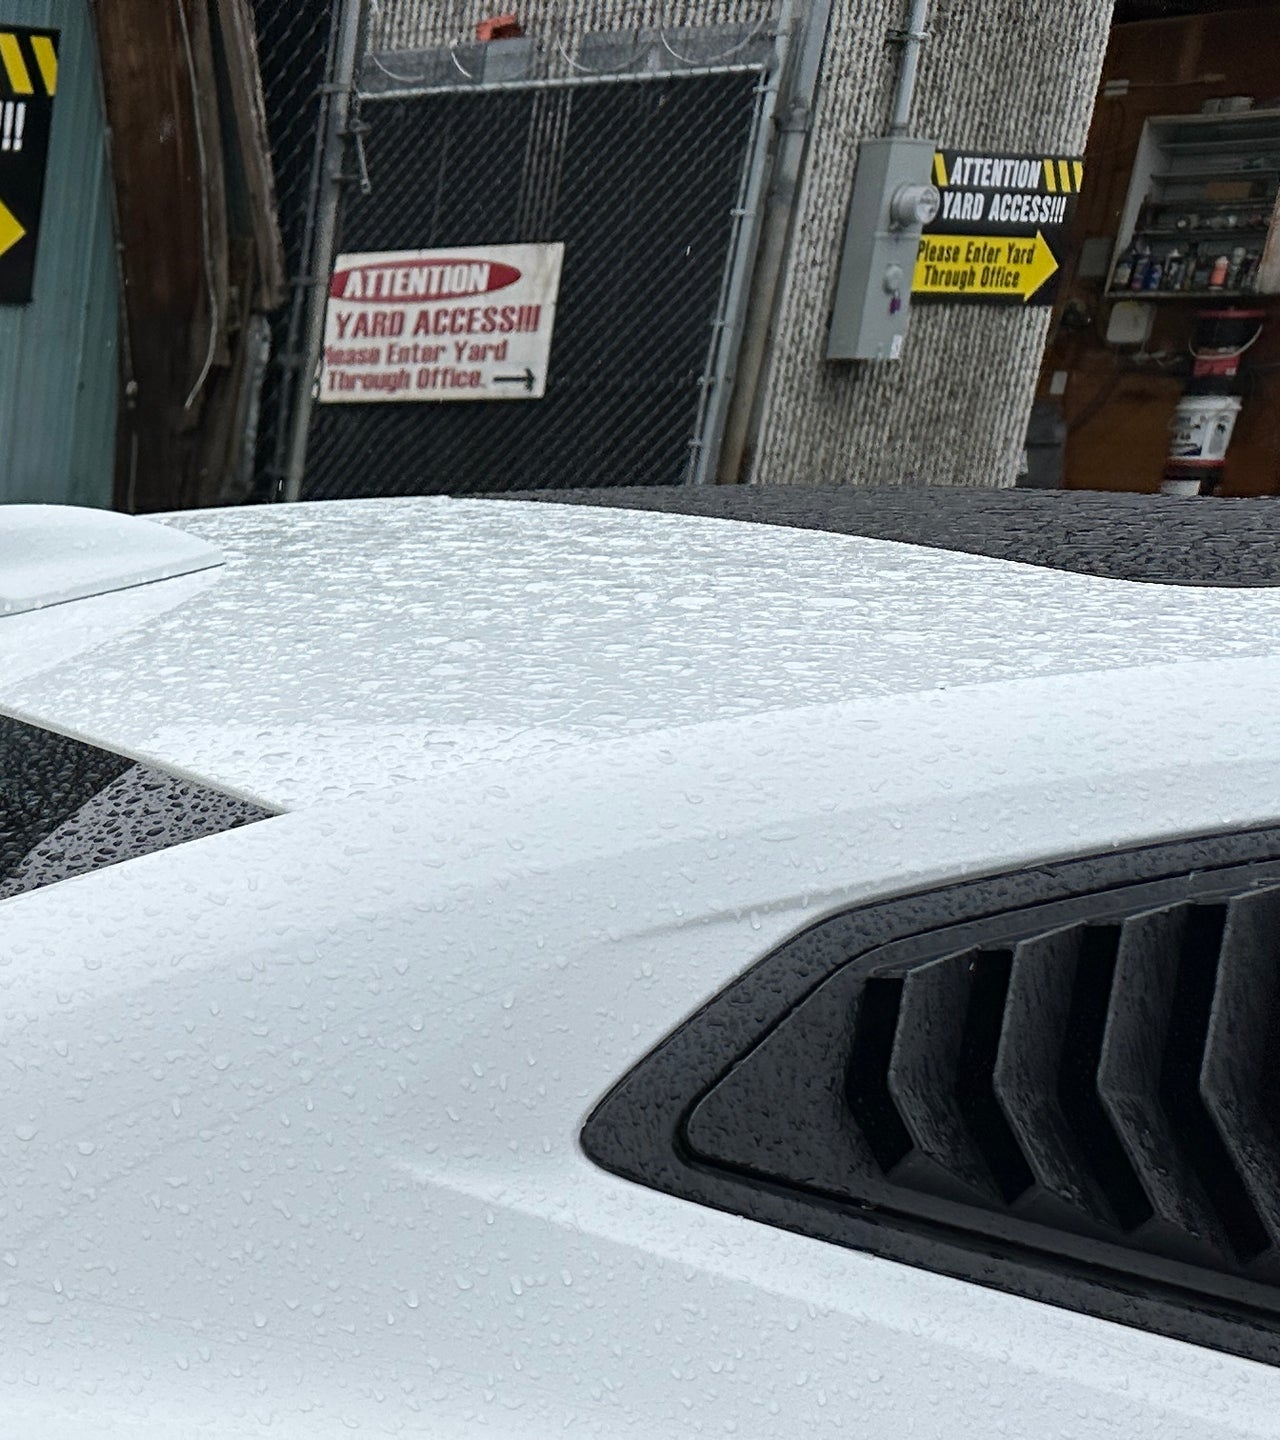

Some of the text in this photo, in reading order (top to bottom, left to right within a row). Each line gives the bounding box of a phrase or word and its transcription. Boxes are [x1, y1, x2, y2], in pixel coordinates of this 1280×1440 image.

[949, 157, 1042, 189] ATTENTION
[942, 190, 1067, 224] YARD ACCESS!!!
[916, 240, 1036, 265] Please Enter Yard
[342, 263, 490, 299] ATTENTION
[924, 265, 1021, 290] Through Office
[335, 310, 406, 339] YARD
[326, 339, 508, 366] lease Enter Yard
[328, 370, 411, 393] Through
